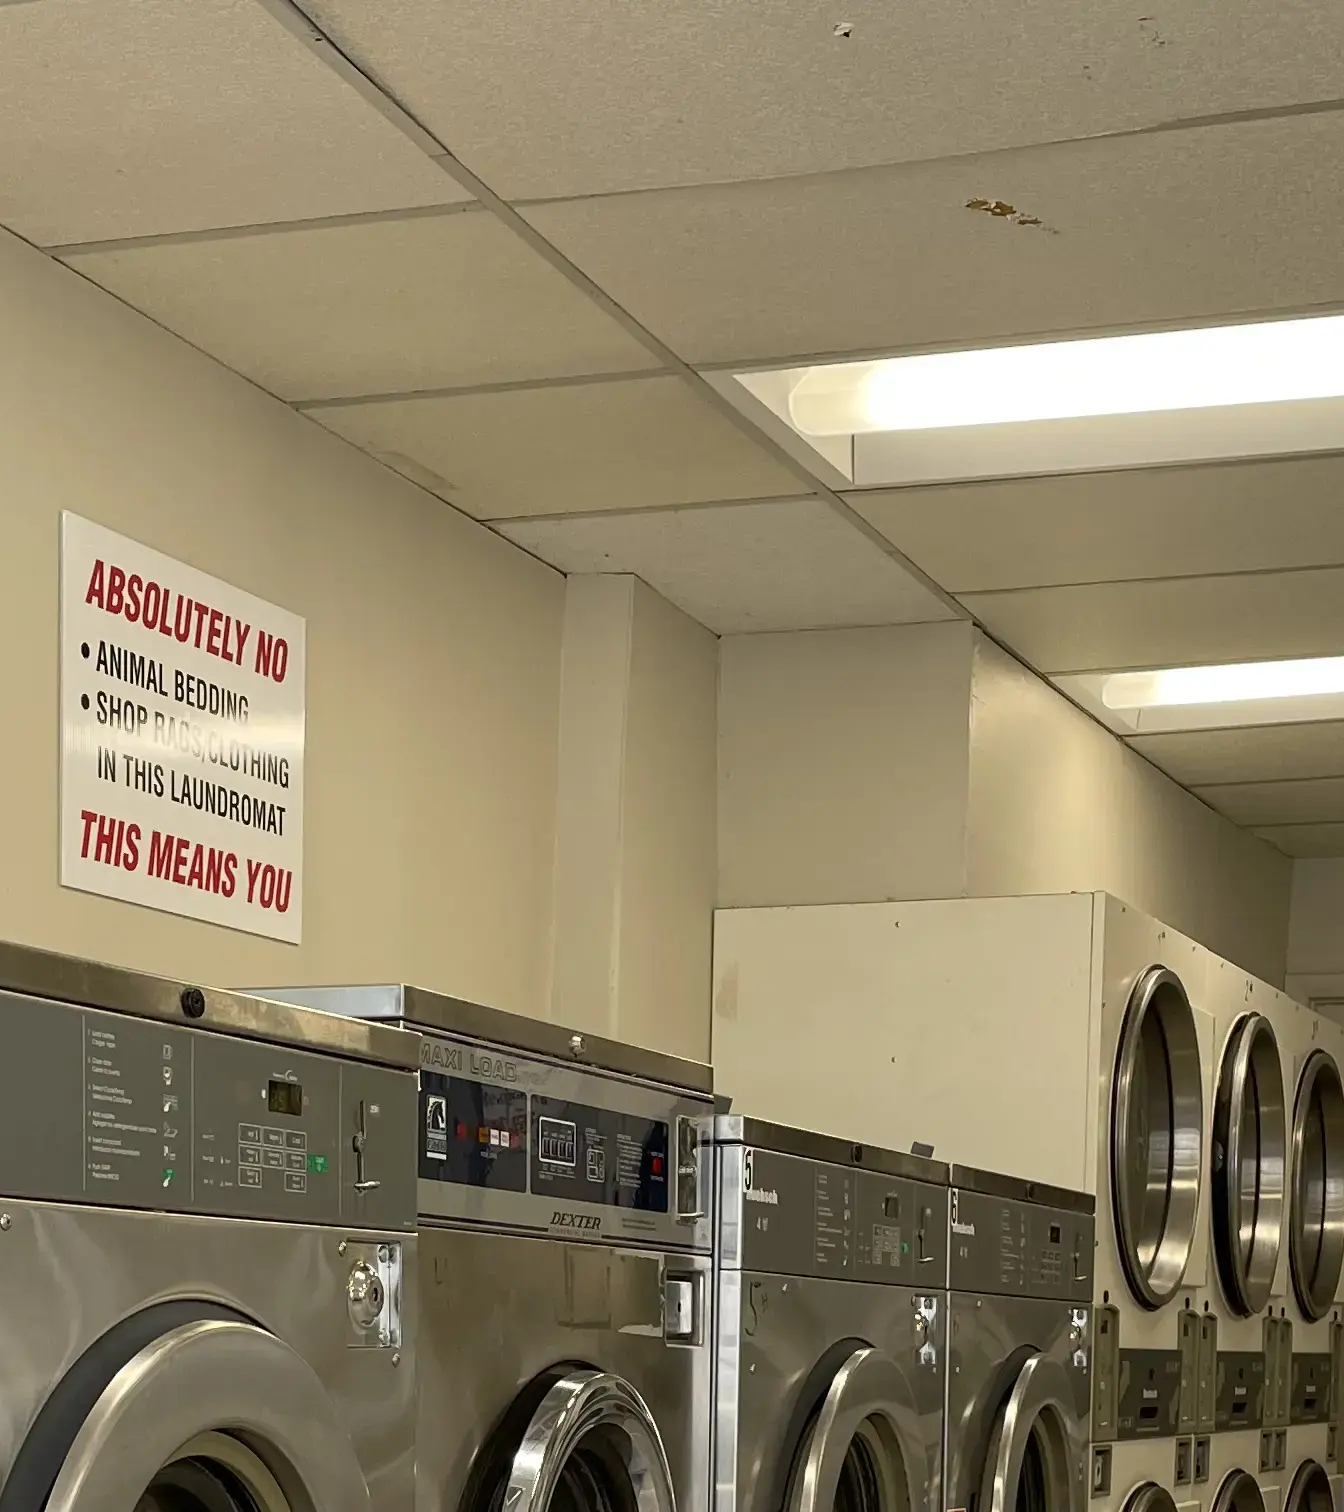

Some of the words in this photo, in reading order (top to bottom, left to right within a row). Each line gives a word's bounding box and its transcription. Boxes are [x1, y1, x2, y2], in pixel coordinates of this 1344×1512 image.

[85, 559, 250, 666] ABSOLUTELY
[255, 630, 288, 682] NO
[96, 639, 168, 698] ANIMAL
[174, 669, 249, 724] BEDDING
[96, 691, 147, 736] SHOP
[155, 711, 289, 789] RAGS/CLOTHING
[98, 746, 116, 783] IN
[123, 755, 164, 797] THIS
[170, 769, 286, 835] LAUNDROMAT
[80, 810, 141, 871] THIS
[147, 831, 238, 898] MEANS
[246, 858, 292, 913] YOU
[470, 1054, 516, 1082] LOAD
[550, 1212, 601, 1230] DEXTER
